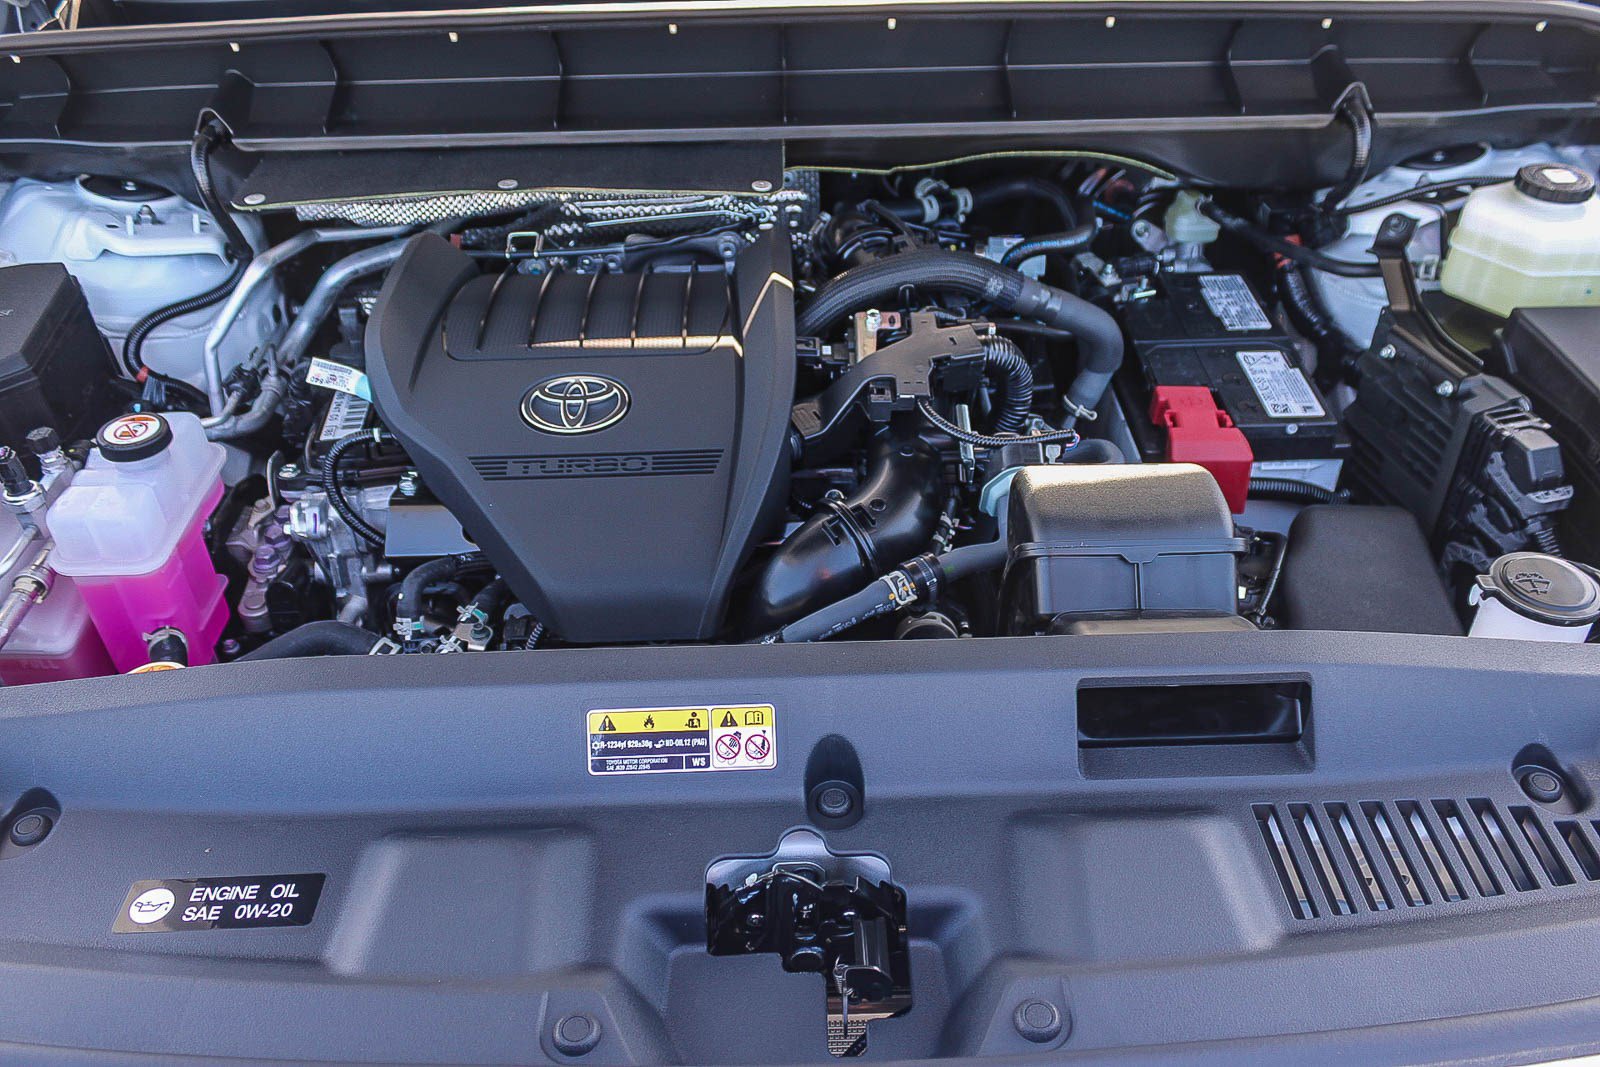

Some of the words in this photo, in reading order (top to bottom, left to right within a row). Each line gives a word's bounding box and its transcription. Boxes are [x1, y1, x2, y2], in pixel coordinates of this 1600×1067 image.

[511, 456, 648, 475] TURBO
[692, 738, 707, 747] (PAG)
[692, 757, 706, 767] WS
[189, 885, 260, 902] ENGINE
[270, 883, 300, 899] OIL
[182, 905, 224, 921] SAE
[234, 903, 293, 919] 0W-20
